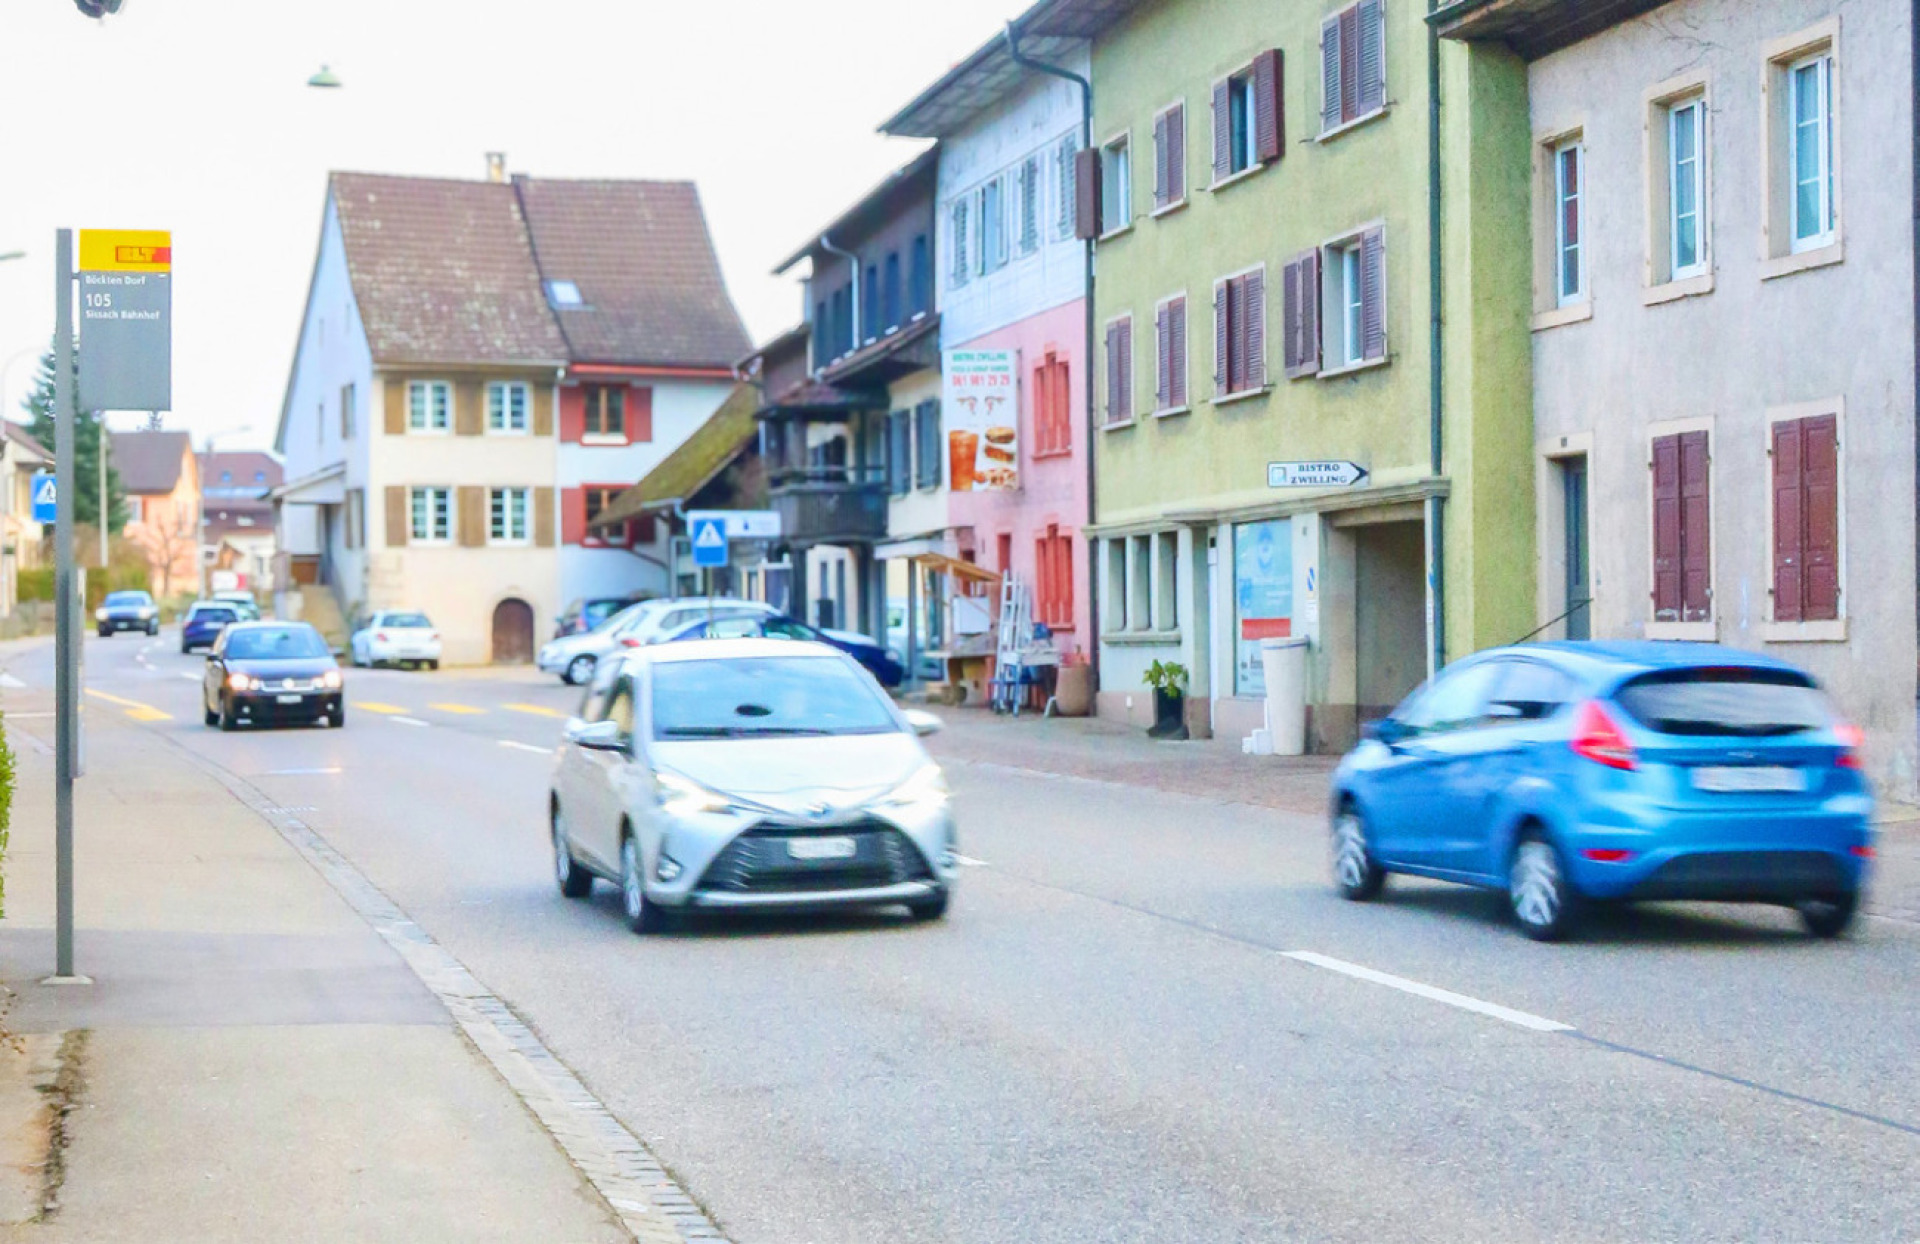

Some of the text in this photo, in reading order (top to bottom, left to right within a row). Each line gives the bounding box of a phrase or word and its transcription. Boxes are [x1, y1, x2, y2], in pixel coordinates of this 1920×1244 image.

[124, 275, 146, 285] Dorf
[86, 293, 112, 307] 105
[85, 309, 160, 319] Sissach Bahnhof
[1298, 463, 1340, 472] BISTRO
[1290, 475, 1348, 484] ZWILLING
